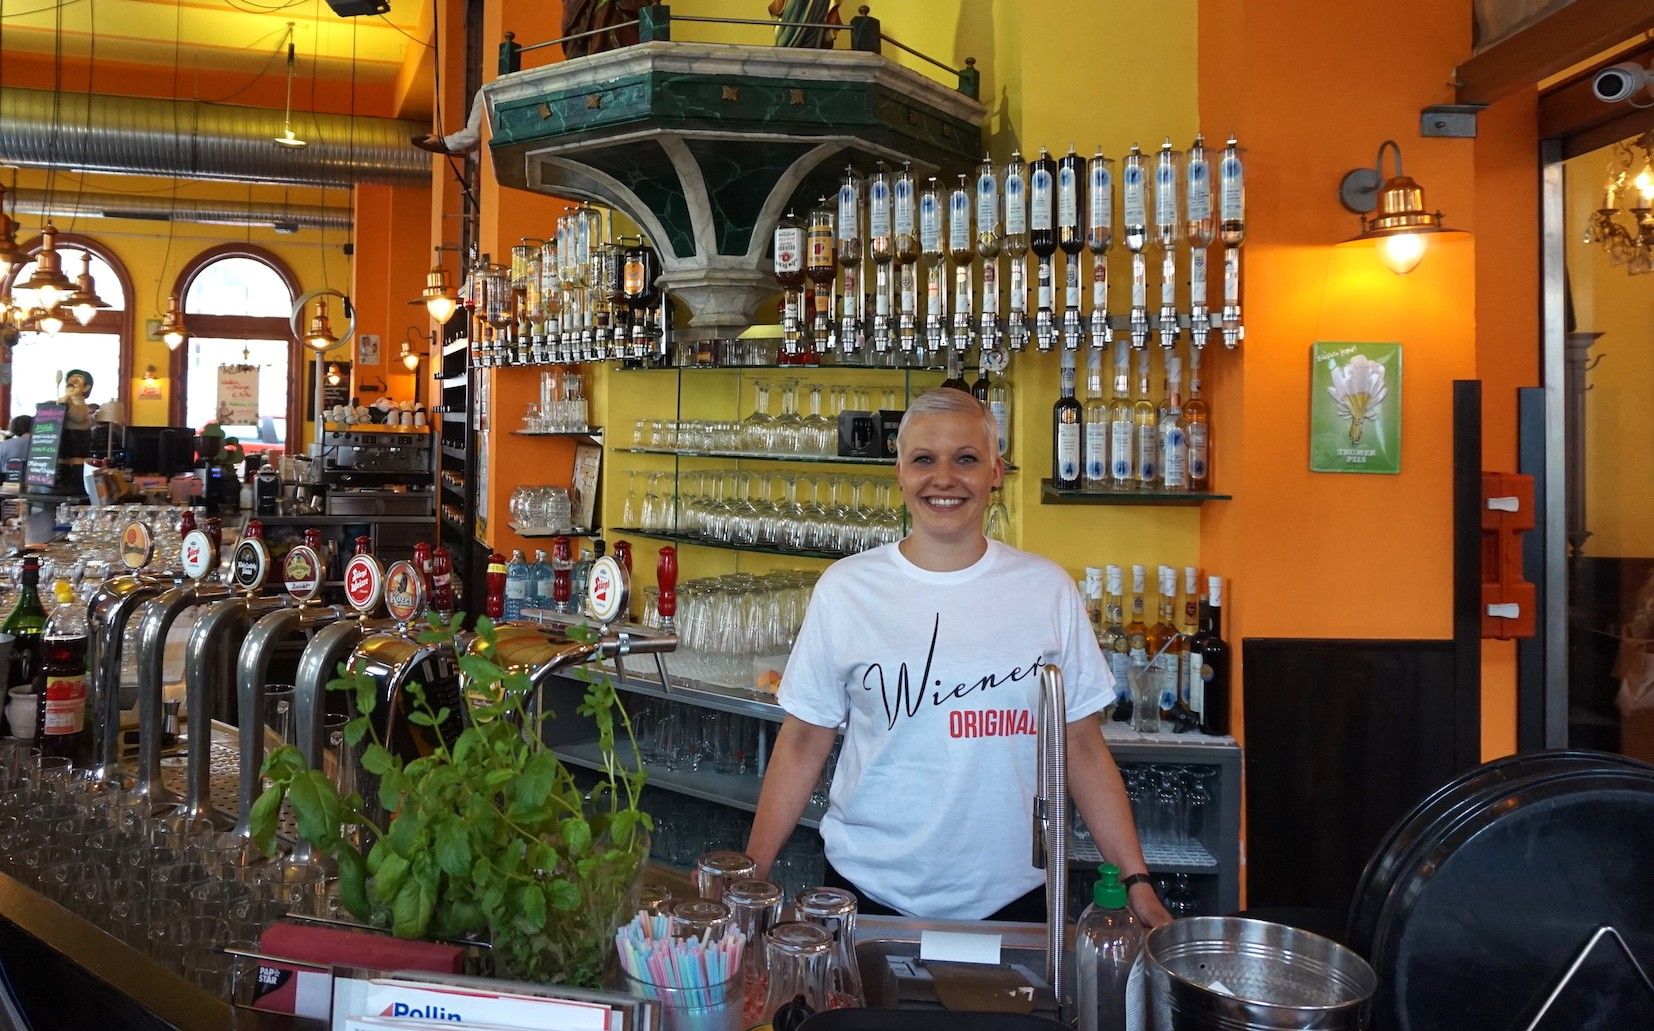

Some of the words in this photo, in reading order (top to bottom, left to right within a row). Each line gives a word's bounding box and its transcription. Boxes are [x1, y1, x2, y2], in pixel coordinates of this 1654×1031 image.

[391, 592, 412, 606] Kozel
[862, 612, 1046, 731] Wiener
[259, 967, 274, 976] PAP
[258, 974, 278, 985] STAR
